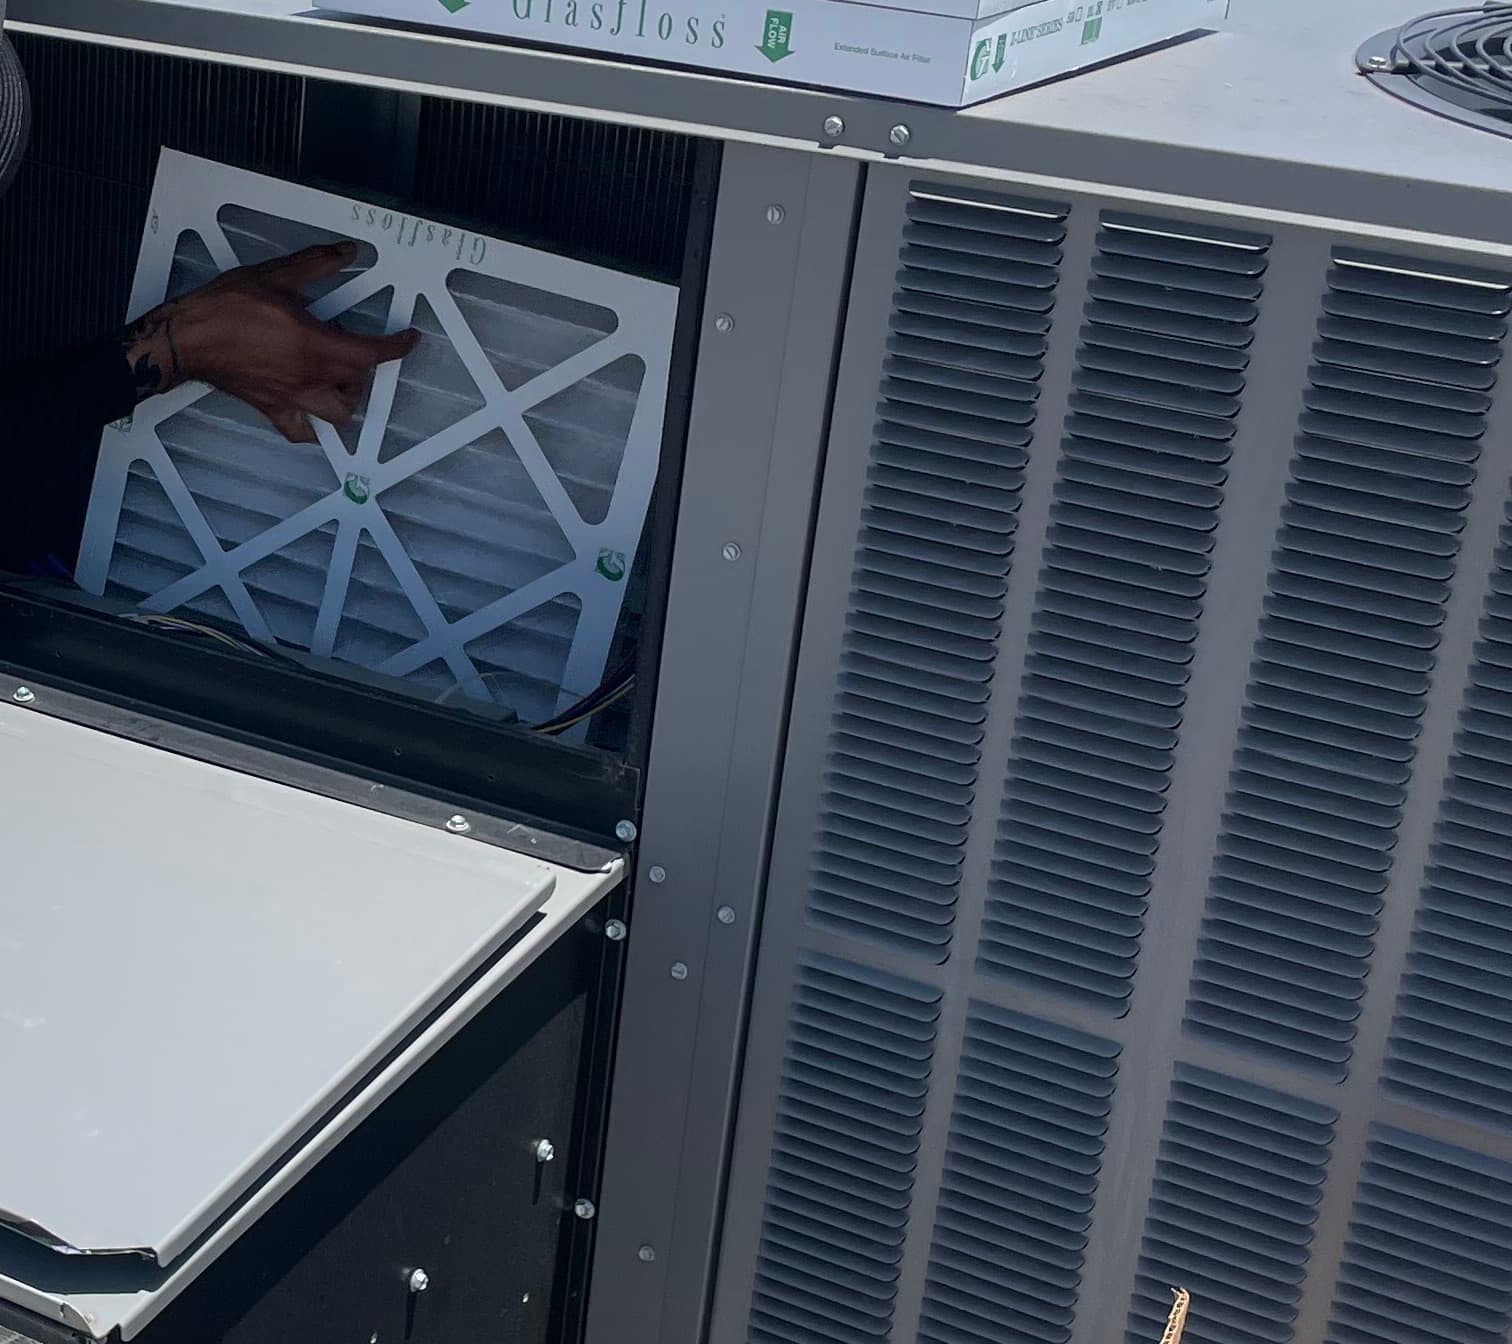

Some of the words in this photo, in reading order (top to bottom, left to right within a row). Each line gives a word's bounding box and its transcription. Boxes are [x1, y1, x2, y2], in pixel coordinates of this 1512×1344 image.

[767, 17, 779, 49] FLOW
[777, 25, 787, 44] AIR
[351, 203, 487, 265] Glasfloss
